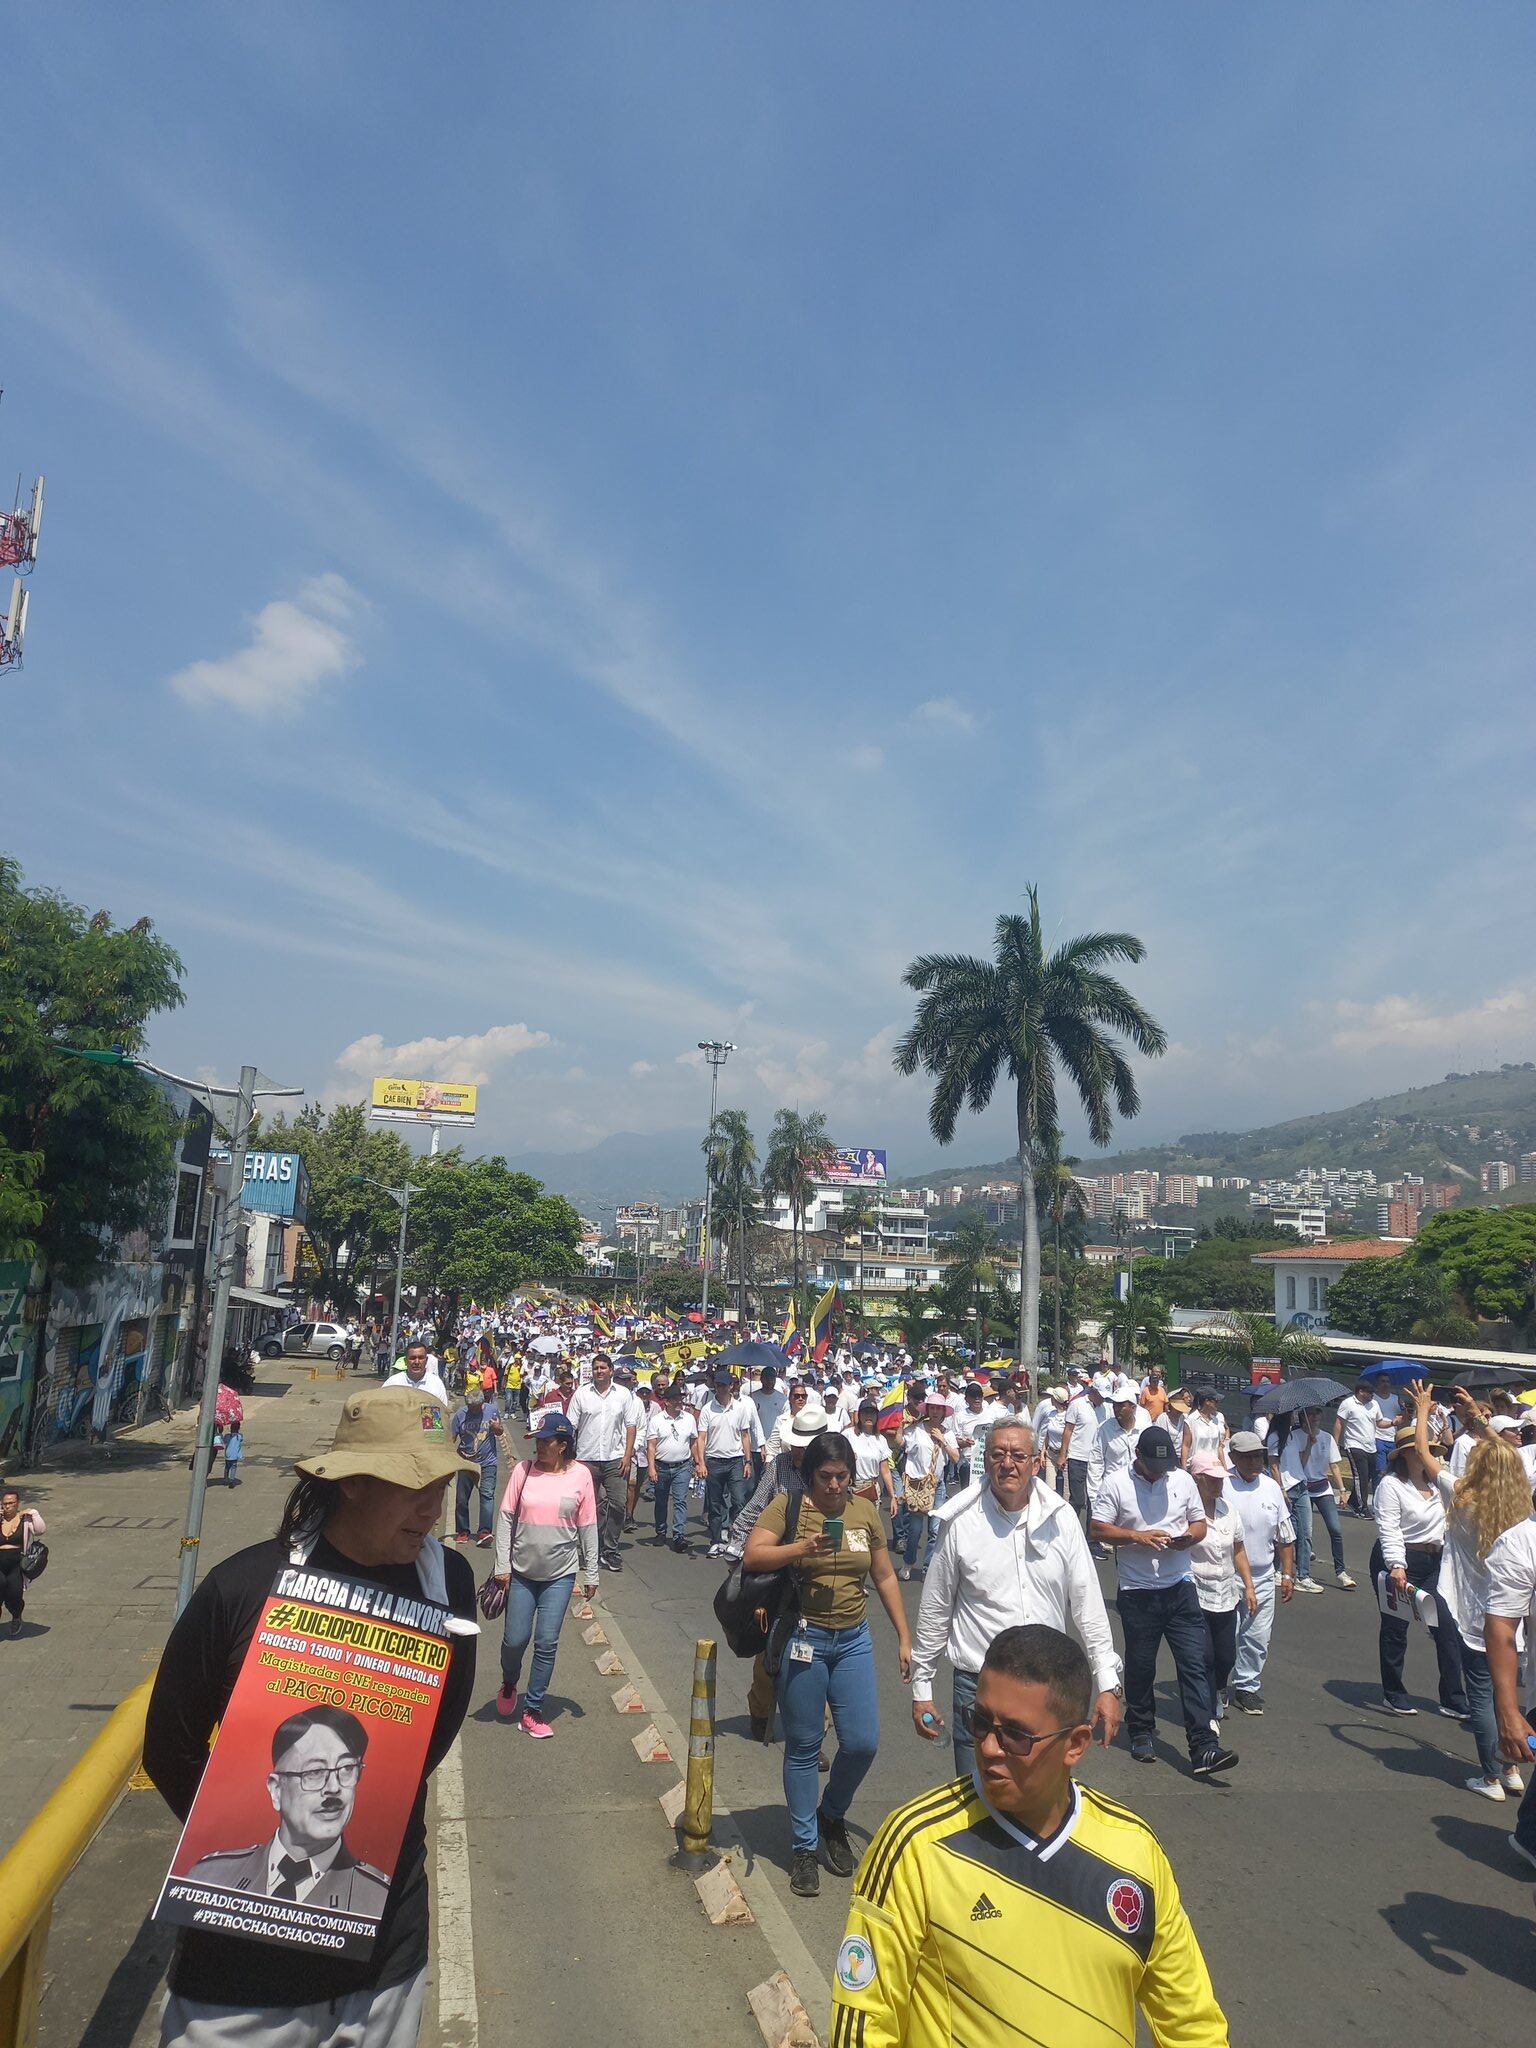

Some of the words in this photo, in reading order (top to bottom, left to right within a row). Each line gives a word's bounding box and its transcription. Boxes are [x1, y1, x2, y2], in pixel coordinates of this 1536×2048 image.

[383, 1094, 397, 1104] CAE
[397, 1095, 412, 1106] BIEN
[663, 1341, 683, 1349] ABAJO
[684, 1337, 703, 1346] PETRO
[276, 1570, 350, 1608] MARCHA
[349, 1585, 375, 1613] DE
[373, 1590, 394, 1618] LA
[258, 1631, 307, 1653] PROCESO
[310, 1642, 343, 1661] 15000
[345, 1650, 354, 1664] Y
[353, 1653, 391, 1674] DINERO
[392, 1663, 440, 1688] NARCOLAS.
[266, 1602, 449, 1670] #JUICIOPOLITICOPETRO
[259, 1651, 340, 1680] Magistradas
[343, 1671, 371, 1688] CNE
[371, 1681, 430, 1704] responden
[267, 1679, 281, 1692] al
[282, 1677, 347, 1706] PACTO
[349, 1692, 413, 1724] PICOTA
[169, 1885, 377, 1938] #FUERADICTADURANARCOMUNISTA
[193, 1909, 346, 1949] #PETROCHAOCHAOCHAO
[970, 1909, 1003, 1922] adidas
